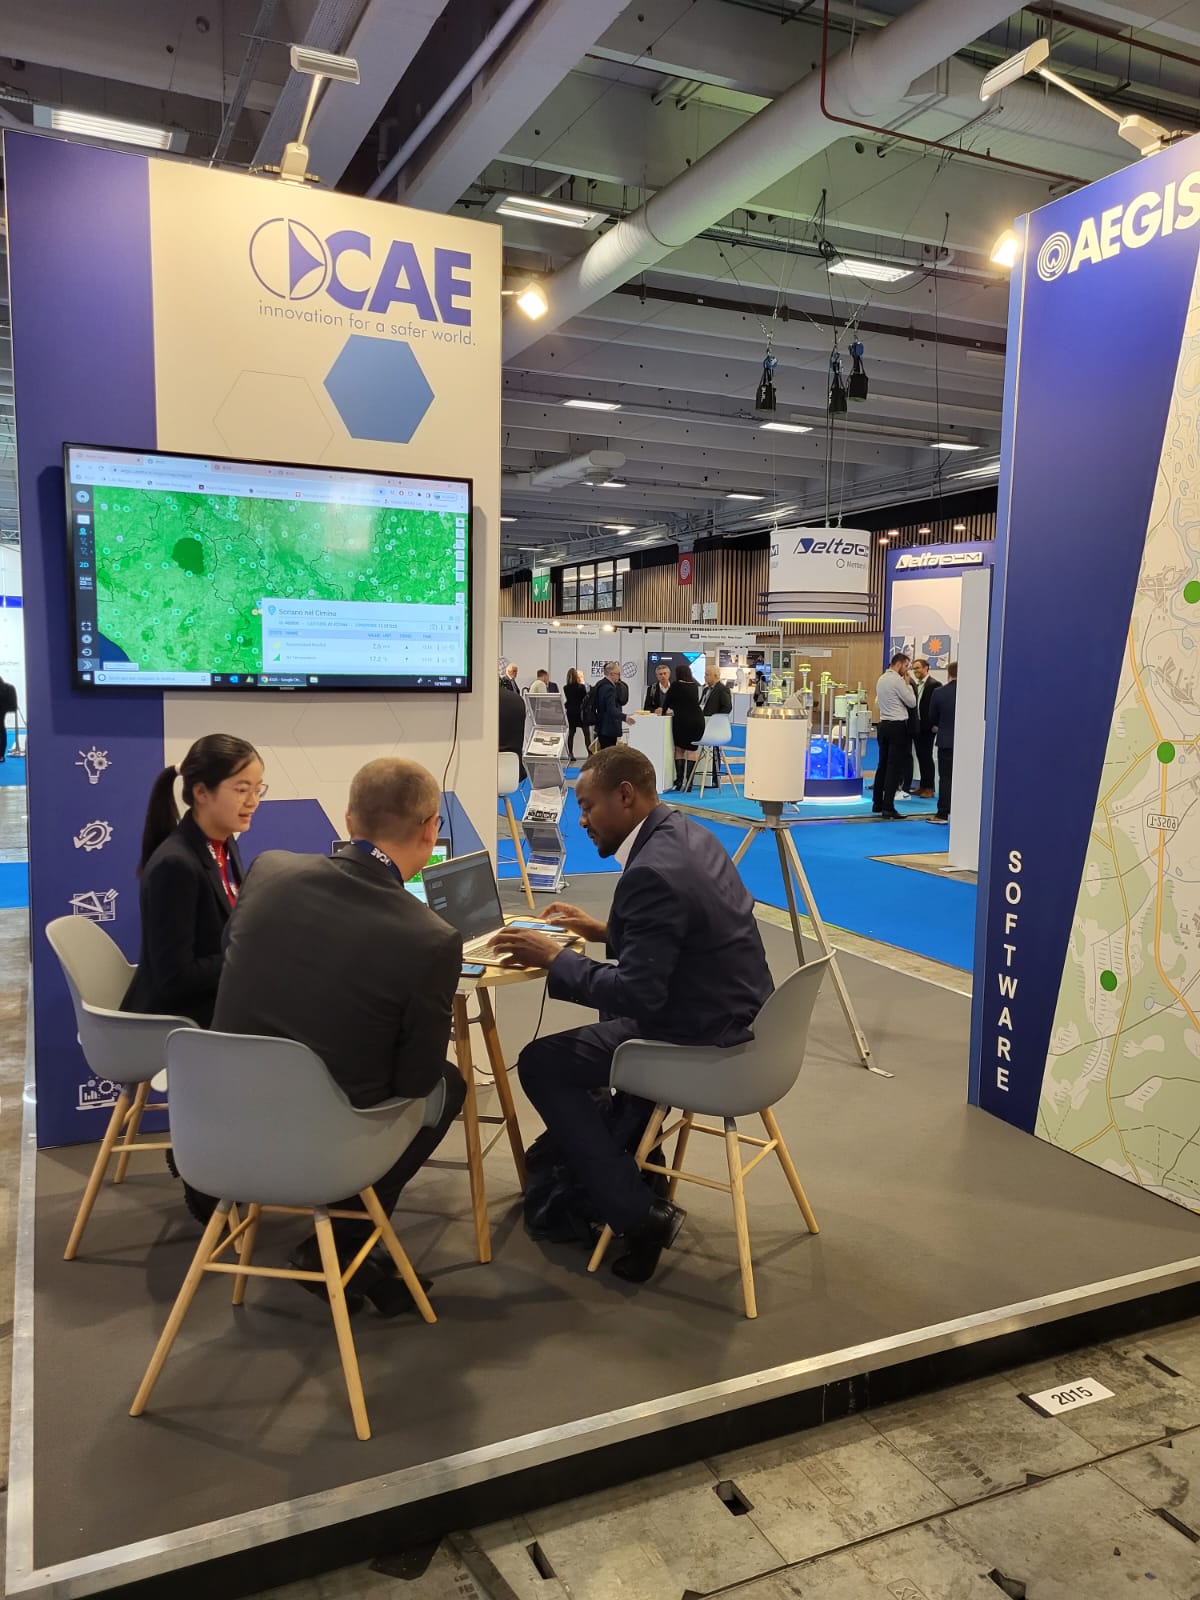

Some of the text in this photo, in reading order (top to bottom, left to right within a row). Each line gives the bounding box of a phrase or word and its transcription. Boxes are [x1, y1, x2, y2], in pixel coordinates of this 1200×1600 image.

[1068, 170, 1200, 274] AEGIS
[258, 300, 476, 346] innovation for a safer world.
[325, 230, 472, 327] CAE
[996, 850, 1022, 1092] SOFTWARE
[1051, 1386, 1093, 1405] 2015
